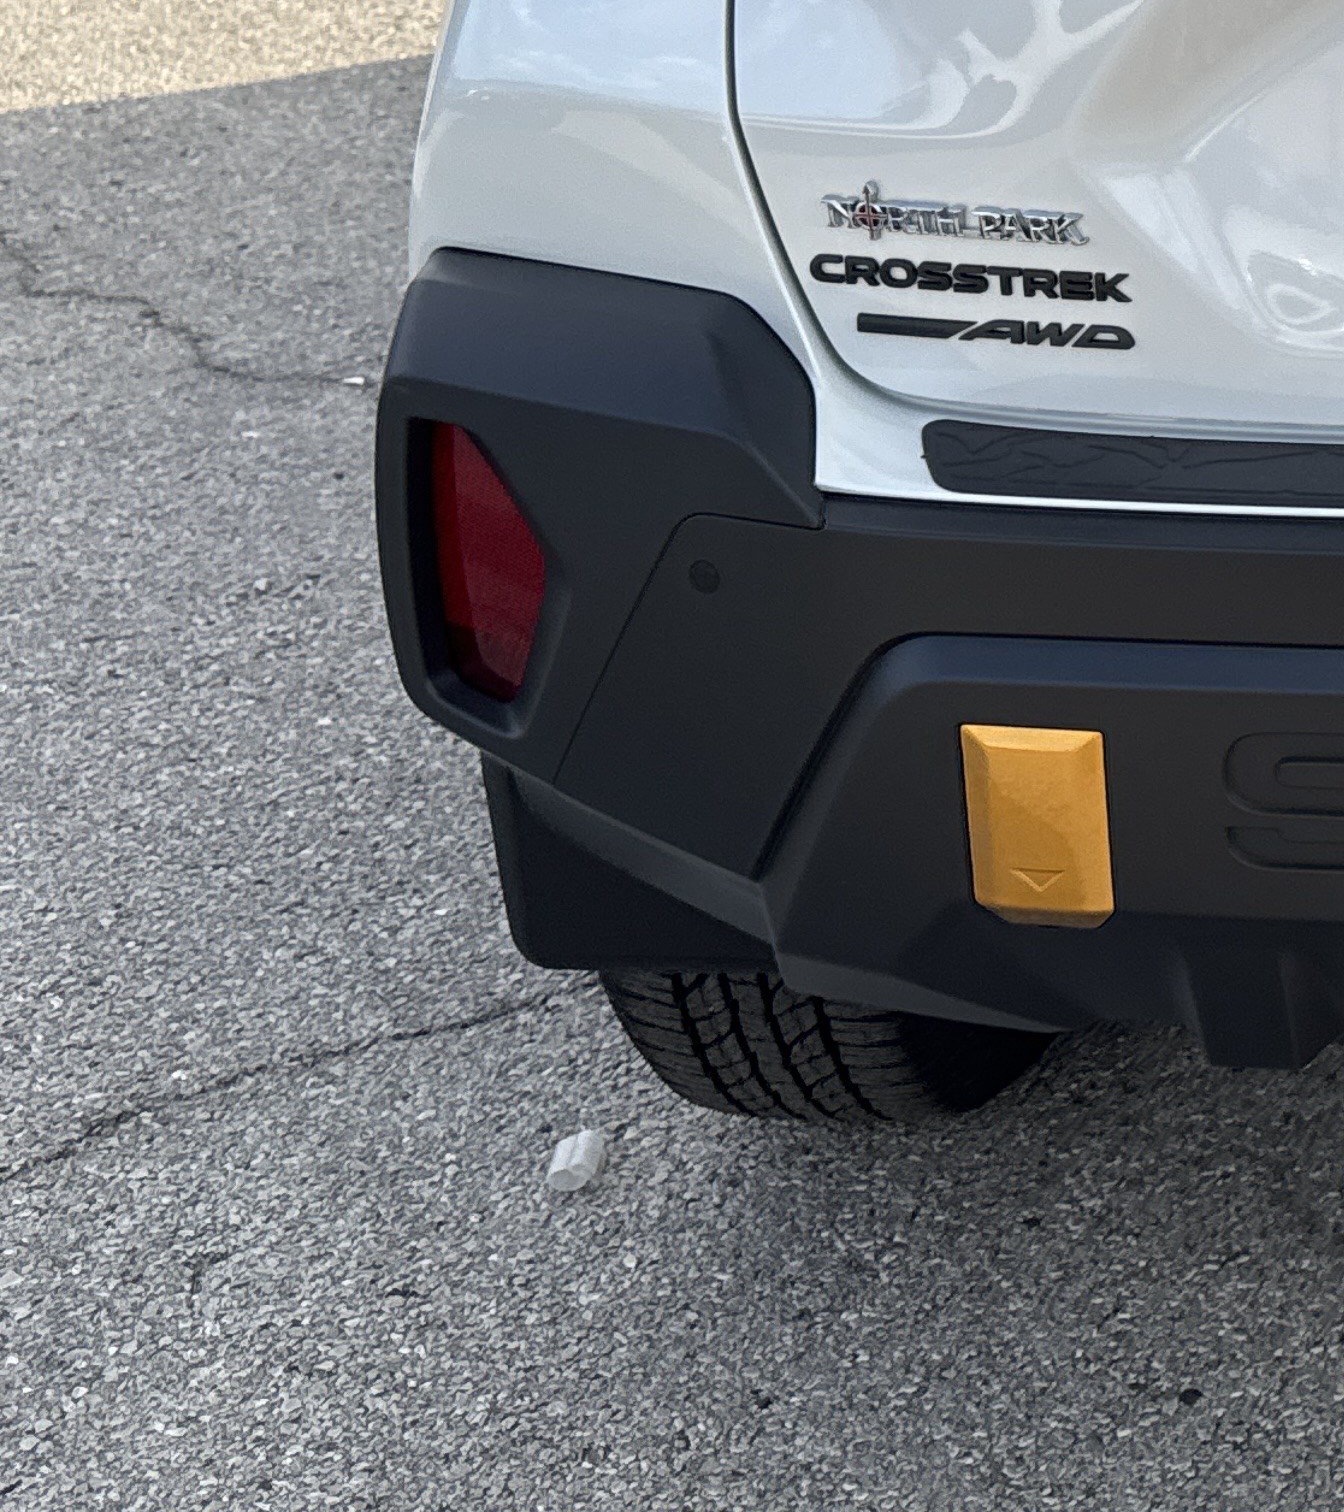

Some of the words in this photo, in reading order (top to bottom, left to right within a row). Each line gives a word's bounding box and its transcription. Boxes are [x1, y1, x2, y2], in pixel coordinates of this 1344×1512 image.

[820, 185, 967, 239] NORTH
[972, 204, 1089, 245] PARK
[809, 253, 1133, 302] CROSSTREK
[957, 319, 1136, 350] AWD
